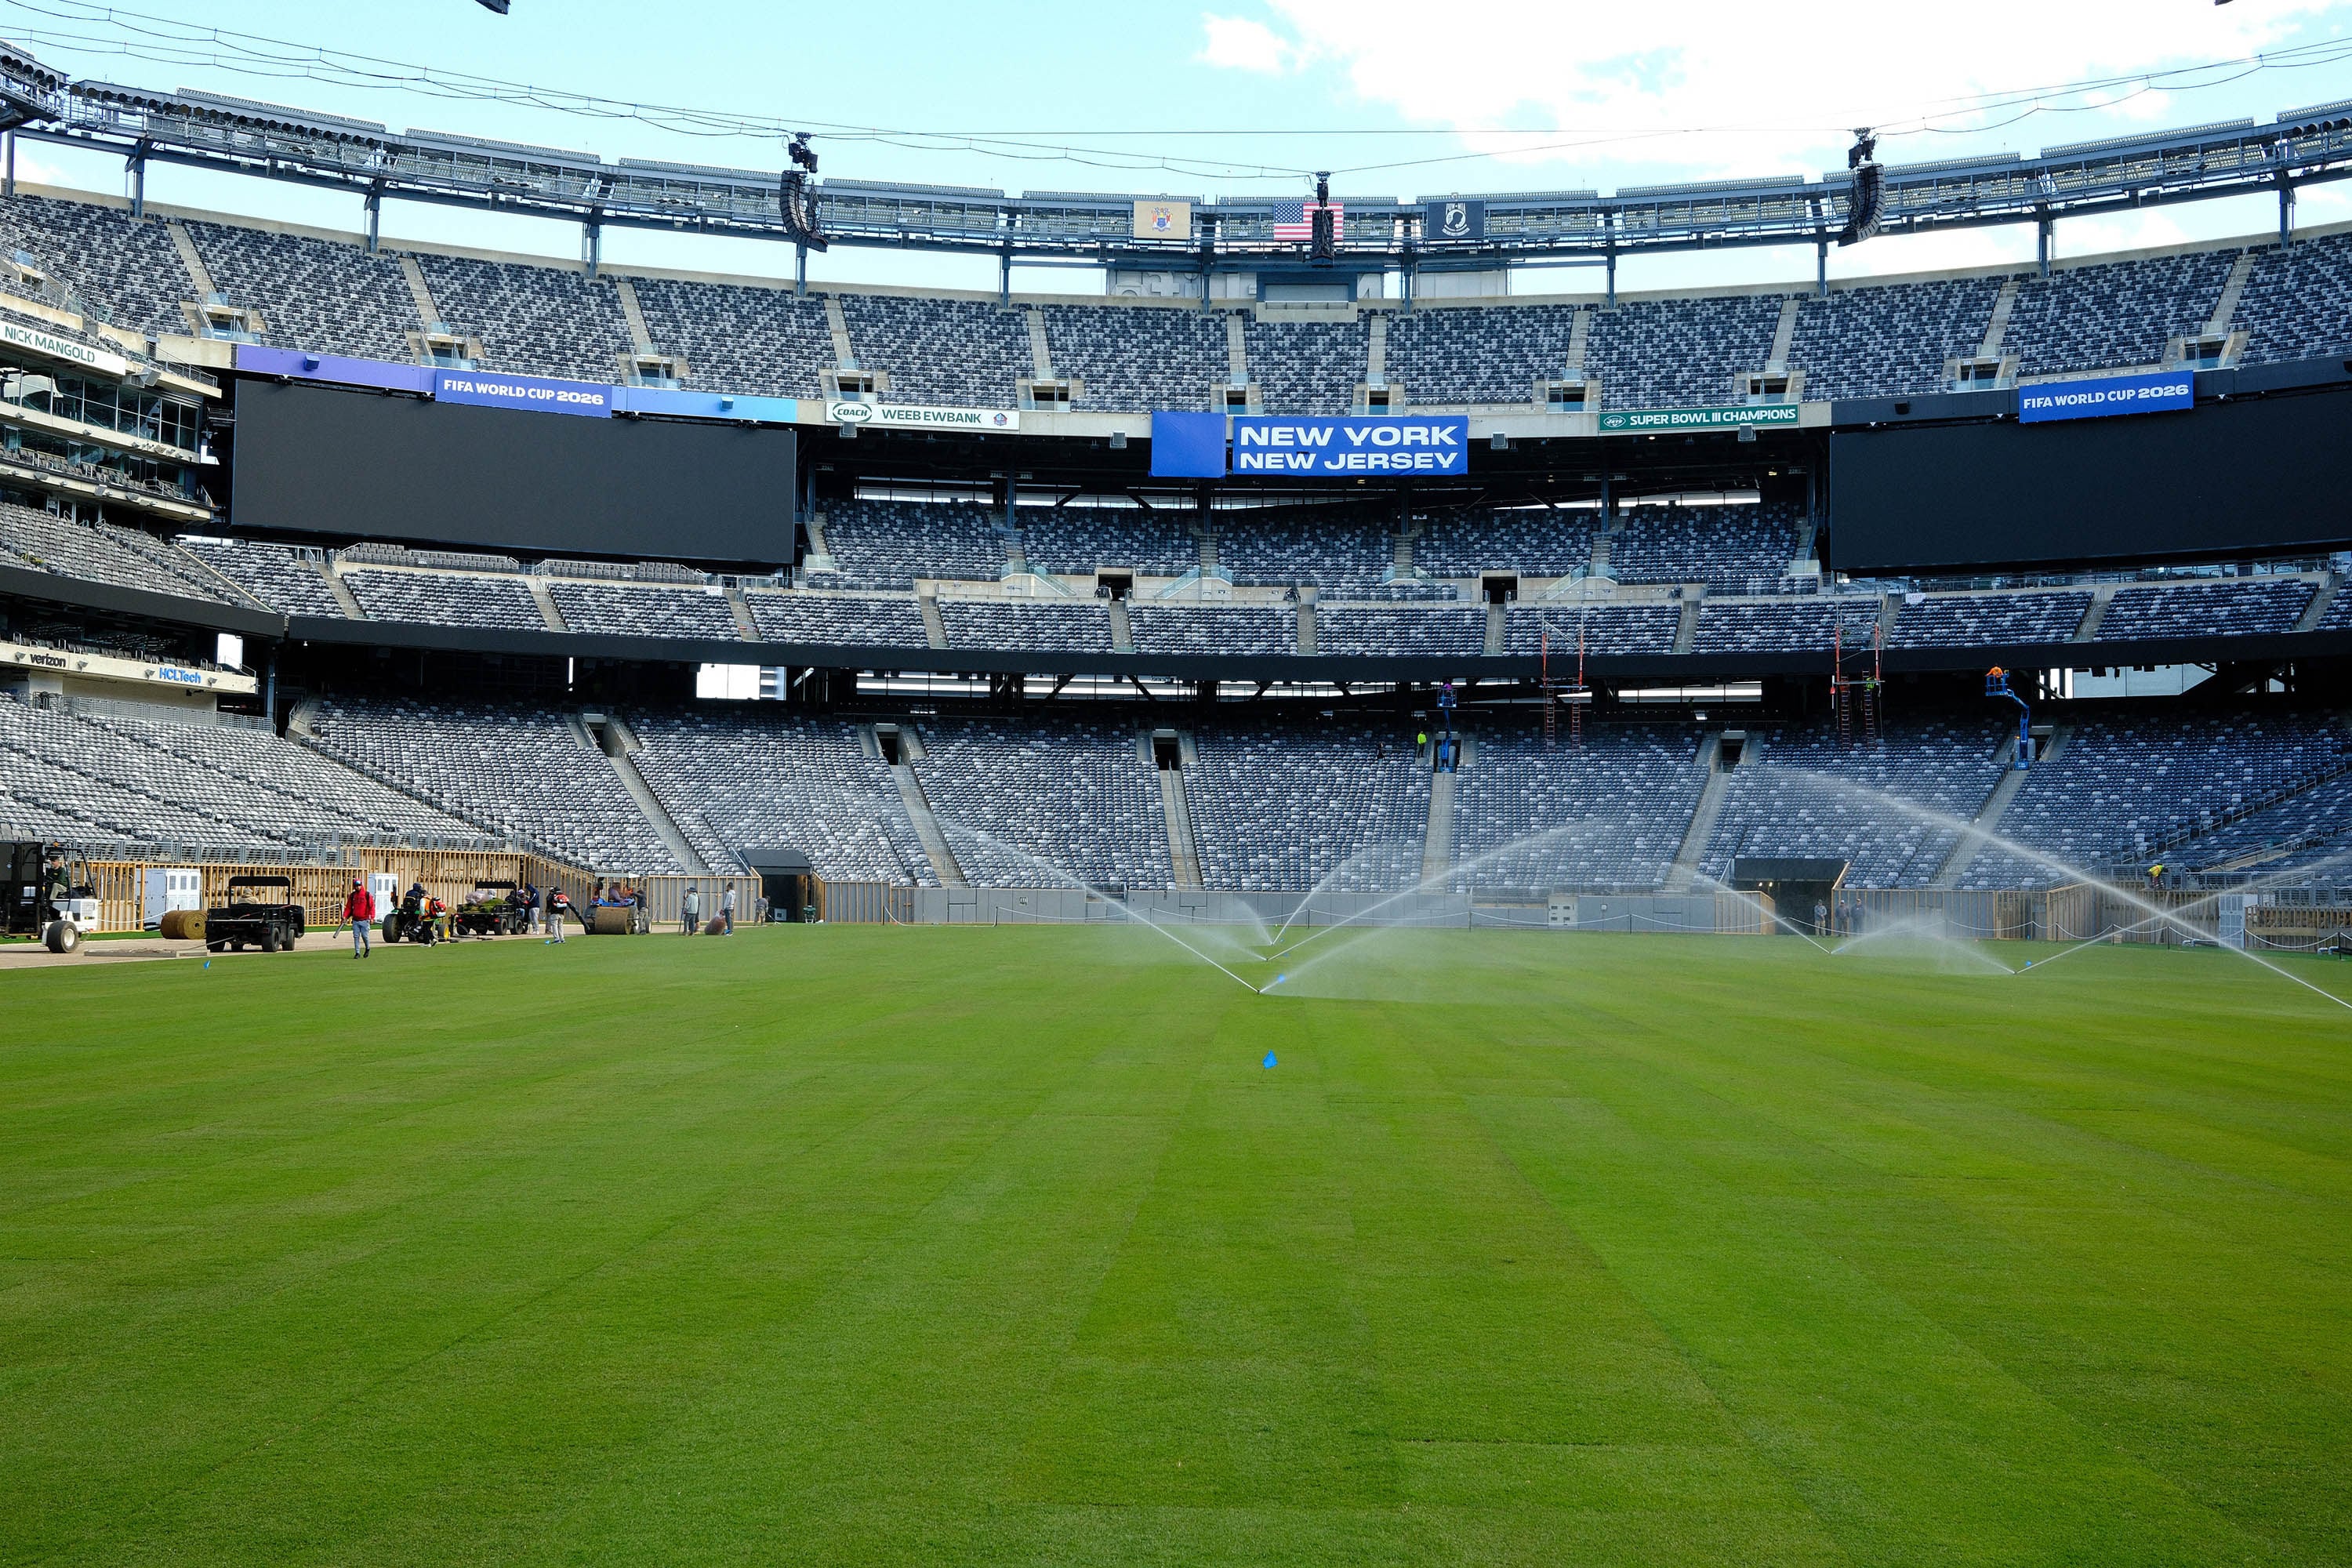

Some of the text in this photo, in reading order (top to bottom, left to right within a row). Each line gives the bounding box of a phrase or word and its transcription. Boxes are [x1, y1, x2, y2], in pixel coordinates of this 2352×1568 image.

[5, 325, 95, 363] NICK MANGOLD
[444, 379, 604, 405] FIFA WORLD CUP 2026
[2024, 384, 2189, 409] FIFA WORLD CUP 2026
[837, 408, 868, 416] COACH
[881, 408, 921, 421] WEEB
[924, 412, 982, 423] EWBANK
[1630, 408, 1796, 426] SUPER BOWL III CHAMPIONS
[1240, 426, 1458, 446] NEW YORK
[1240, 452, 1459, 470] NEW JERSEY
[30, 652, 66, 667] verizon
[159, 666, 201, 684] HCLTech
